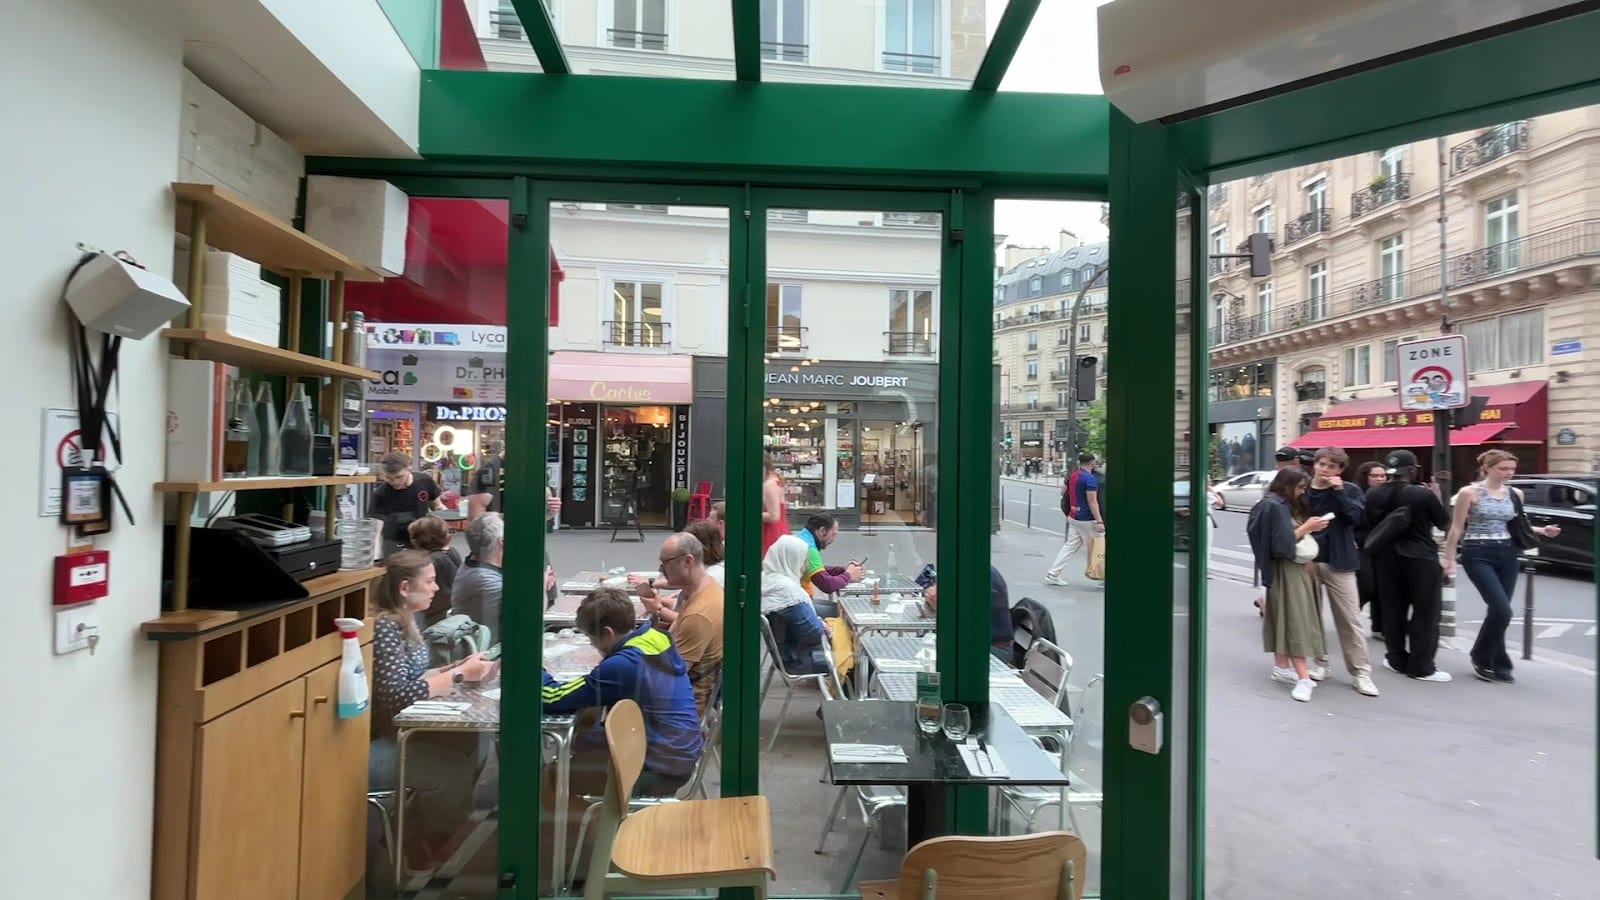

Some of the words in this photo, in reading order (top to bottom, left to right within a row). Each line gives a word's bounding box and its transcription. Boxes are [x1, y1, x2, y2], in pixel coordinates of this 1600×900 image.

[471, 330, 505, 343] Lyca
[1409, 346, 1452, 360] ZONE
[456, 366, 478, 379] Dr.
[764, 373, 799, 384] JEAN
[802, 374, 845, 385] MARC
[849, 375, 908, 387] JOUBERT
[367, 386, 399, 395] Mobile
[590, 381, 652, 400] Cactus
[1317, 418, 1367, 429] RESTAURANT
[677, 414, 687, 465] BIJOUX
